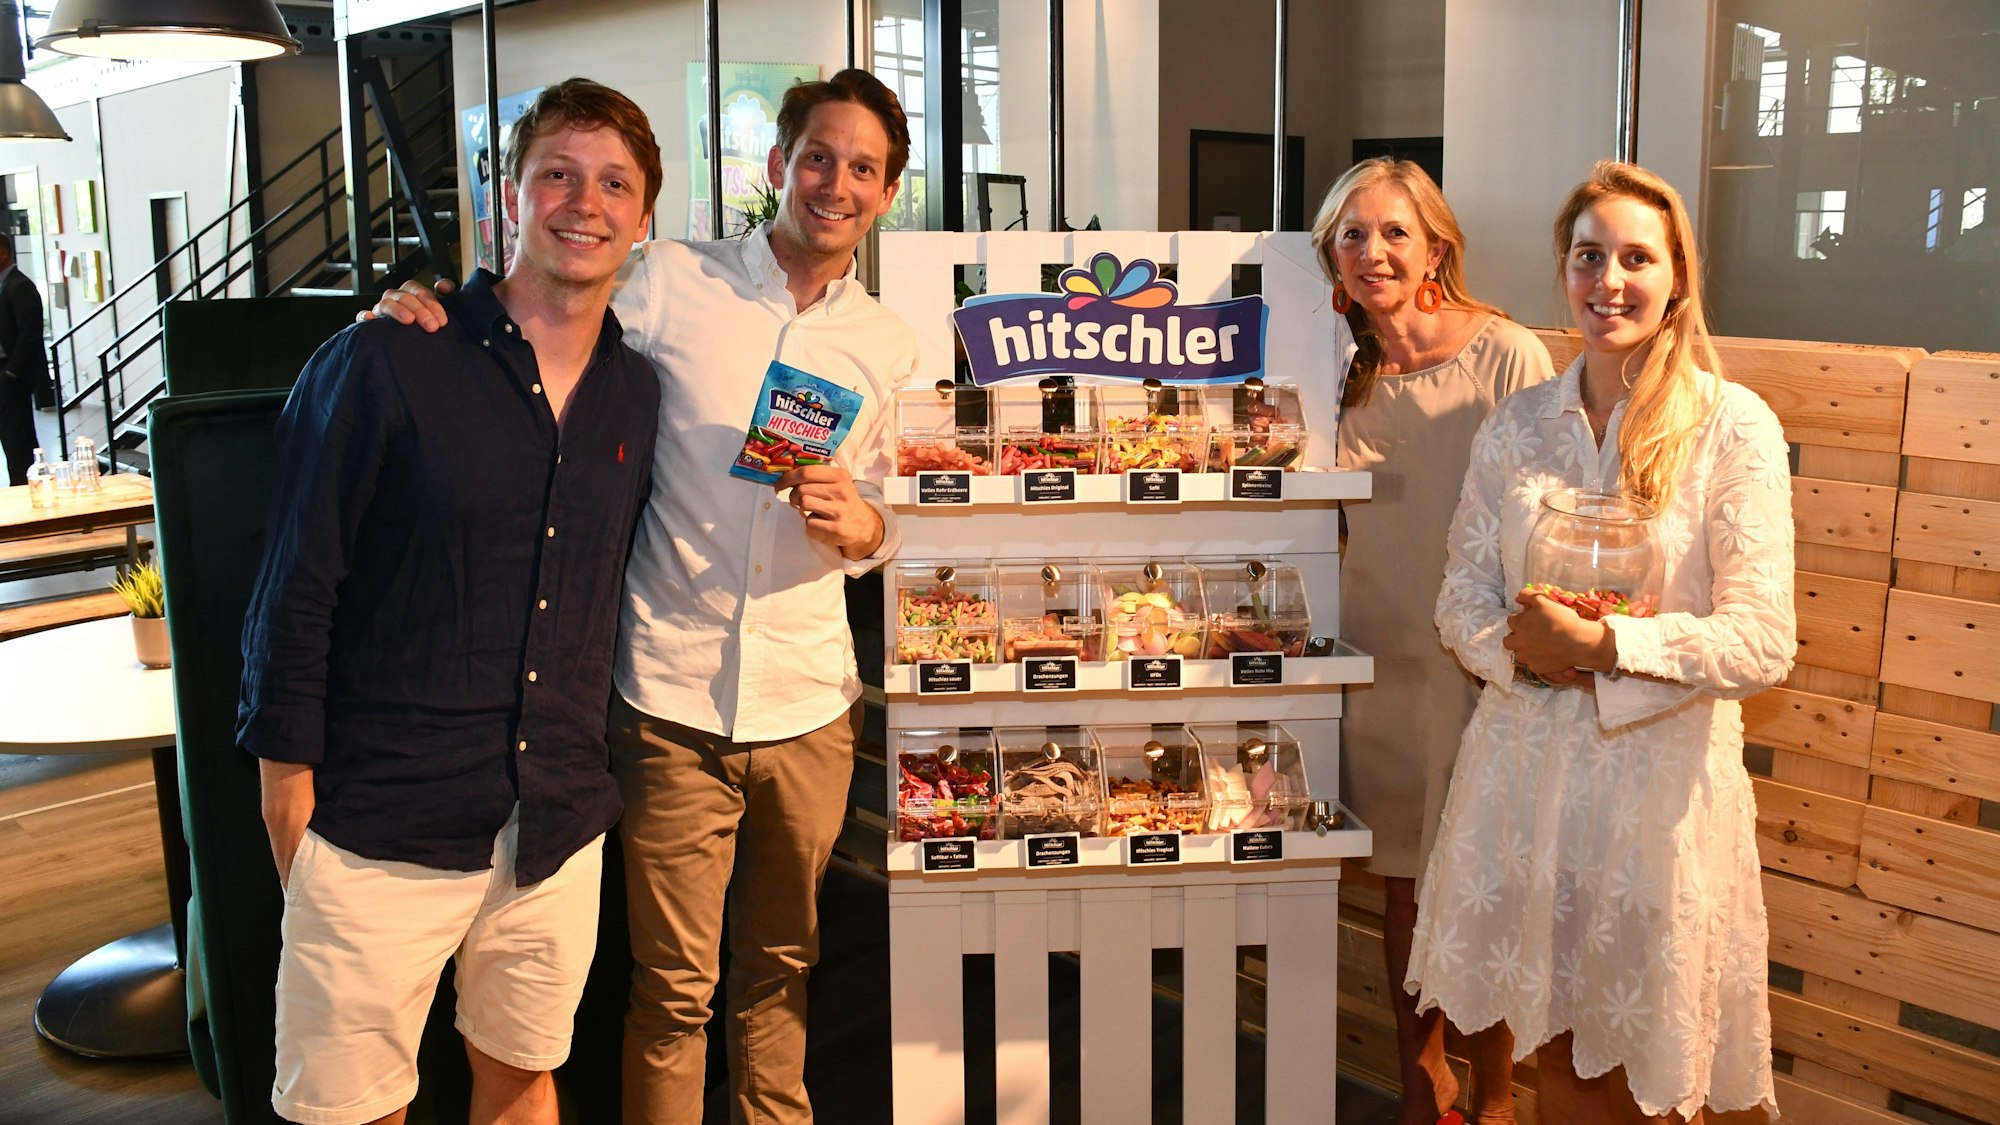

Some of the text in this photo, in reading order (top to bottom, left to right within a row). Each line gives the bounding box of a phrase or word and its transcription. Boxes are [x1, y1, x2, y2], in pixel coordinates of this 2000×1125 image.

[988, 309, 1240, 366] hitschler
[775, 394, 835, 427] hitschler
[767, 415, 830, 442] HITSCHIES
